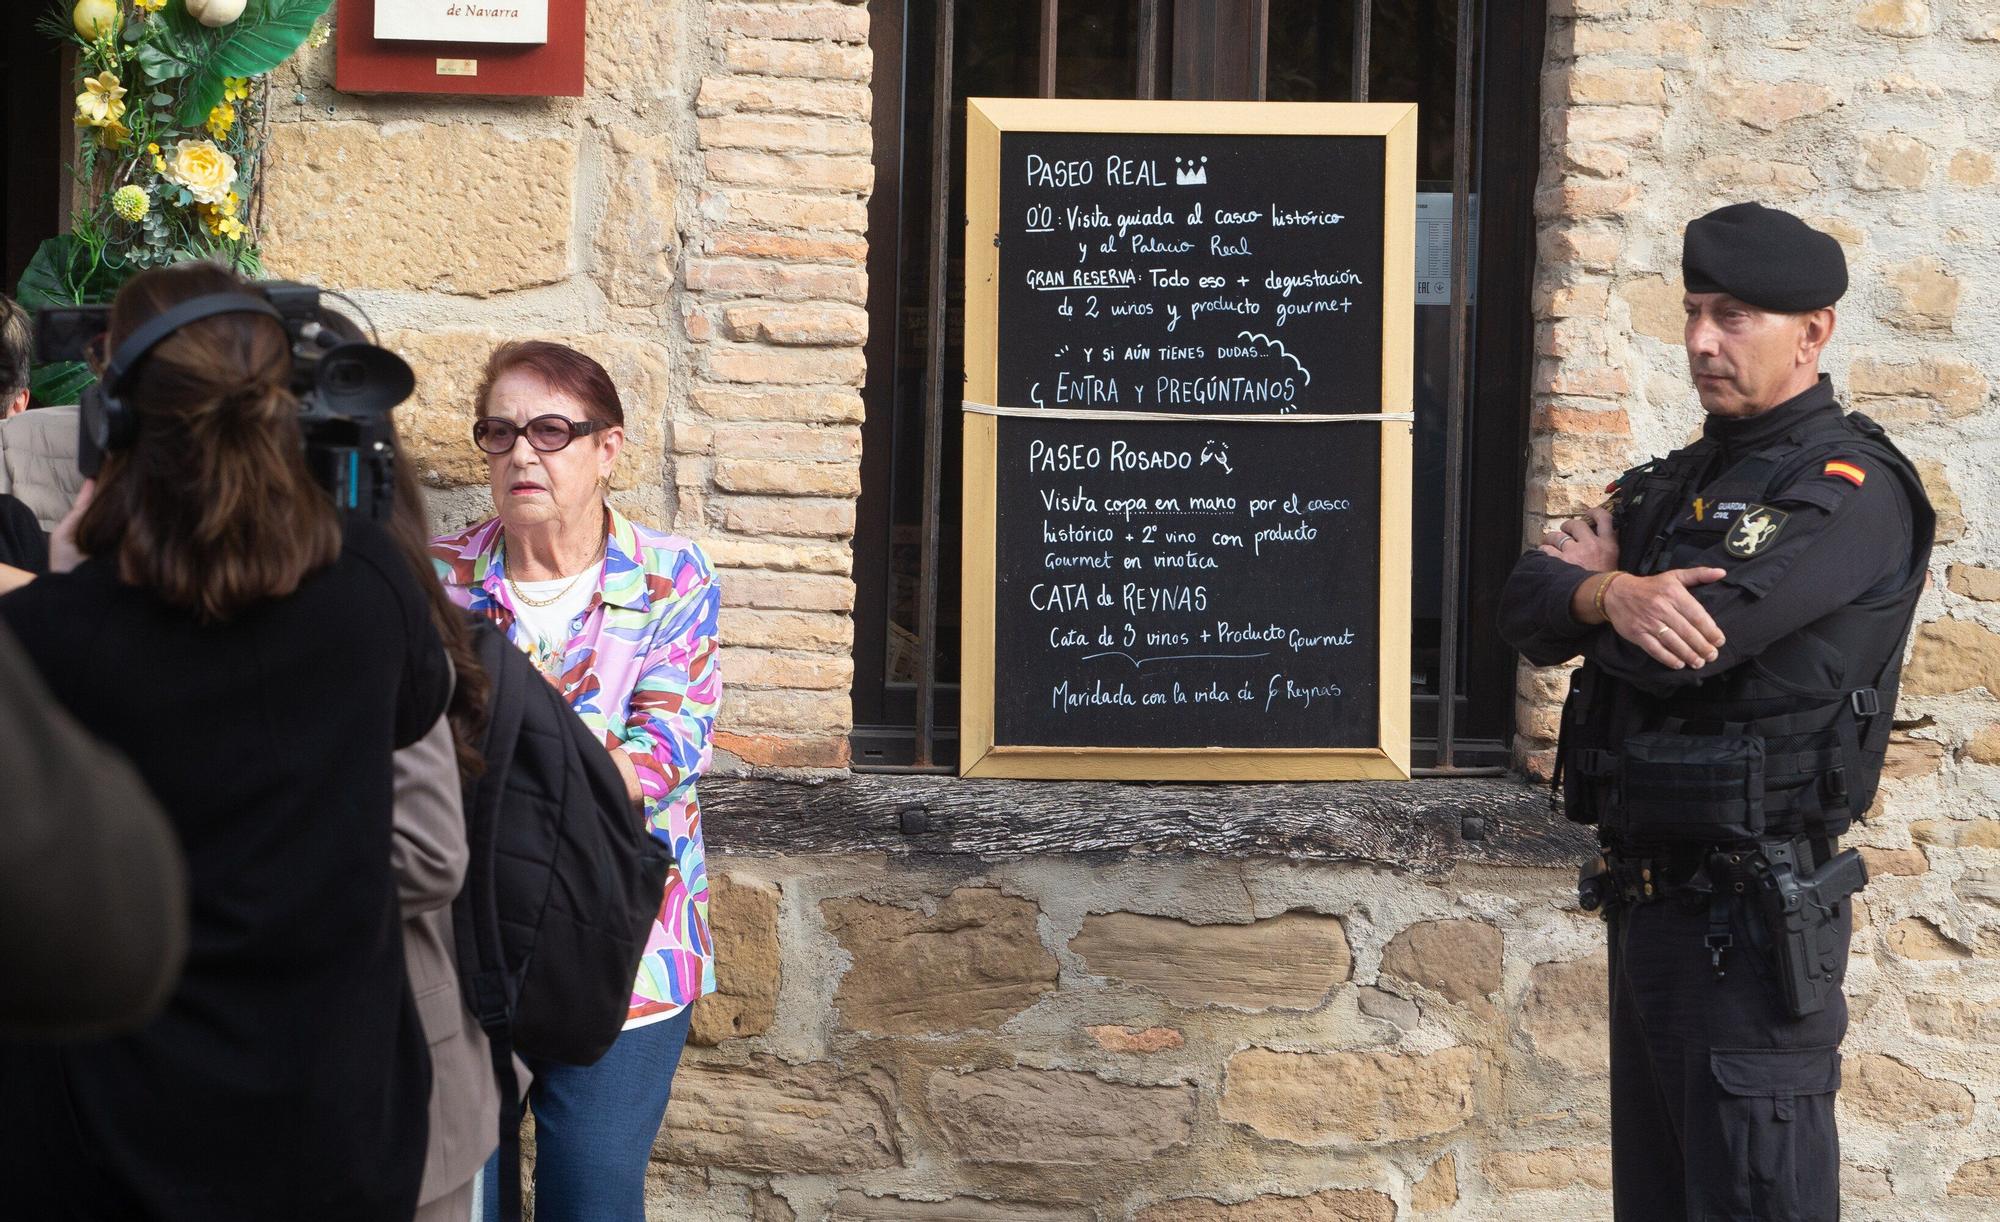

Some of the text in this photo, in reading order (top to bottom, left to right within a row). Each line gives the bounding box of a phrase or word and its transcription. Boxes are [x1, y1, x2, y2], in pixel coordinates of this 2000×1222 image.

[447, 3, 519, 18] de Navarra
[1028, 155, 1166, 187] PASEO REAL
[1067, 204, 1112, 231] Visita
[1117, 207, 1174, 237] guiada
[1187, 202, 1203, 225] al
[1215, 210, 1262, 224] casco
[1272, 203, 1344, 226] histórico
[1079, 234, 1252, 263] y al Palacio Real
[1027, 270, 1065, 288] GRAN
[1149, 269, 1189, 287] Todo
[1199, 277, 1225, 288] eso
[1237, 276, 1249, 286] +
[1265, 269, 1362, 296] degustación
[1058, 296, 1073, 316] de
[1085, 296, 1099, 318] 2
[1167, 304, 1181, 332] y
[1192, 296, 1259, 320] producto
[1277, 297, 1352, 326] gourmet
[1084, 348, 1093, 362] Y
[1124, 344, 1150, 360] AÚN
[1057, 372, 1118, 405] ENTRA
[1158, 376, 1296, 405] PREGÚNTANOS
[1030, 440, 1191, 472] PASEO ROSADO
[1041, 486, 1350, 521] Visita copa en mano por el casco
[1712, 512, 1730, 520] CIVIL
[1718, 502, 1747, 510] GUARDIA
[1044, 520, 1113, 543] histórico
[1166, 531, 1196, 543] vino
[1213, 533, 1243, 547] con
[1255, 524, 1317, 556] producto
[1045, 552, 1218, 569] Gourmet en vinoteca
[1030, 583, 1206, 616] CATA de REYNAS
[1051, 621, 1354, 652] Cata de 3 vinos + Producto Gourmet
[1053, 680, 1136, 713] Maridada
[1143, 694, 1166, 705] con
[1174, 682, 1187, 704] la
[1195, 684, 1229, 702] vida
[1238, 681, 1254, 700] de
[1287, 680, 1341, 708] Reynas
